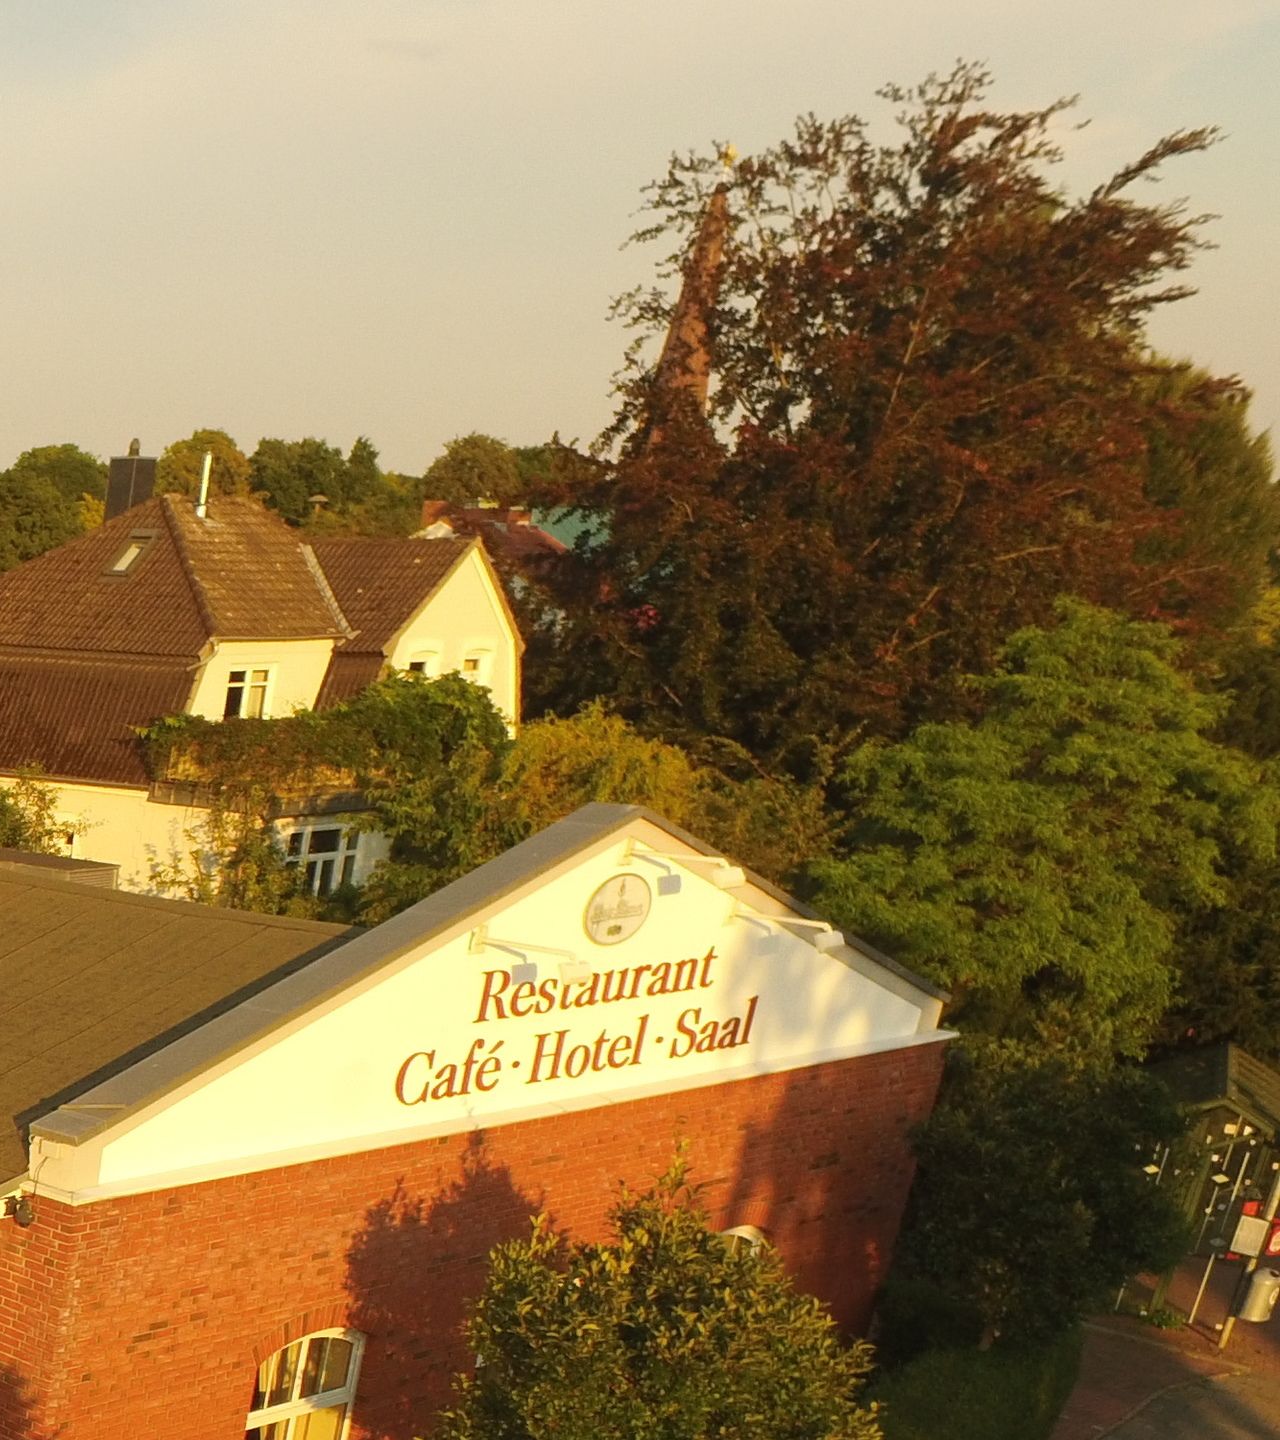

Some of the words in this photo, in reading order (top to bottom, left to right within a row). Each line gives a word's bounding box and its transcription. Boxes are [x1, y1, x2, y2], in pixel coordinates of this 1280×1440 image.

[472, 946, 718, 1024] Restaurant
[394, 1038, 505, 1106] Café
[525, 1014, 649, 1085] Hotel
[668, 995, 759, 1059] Saal
